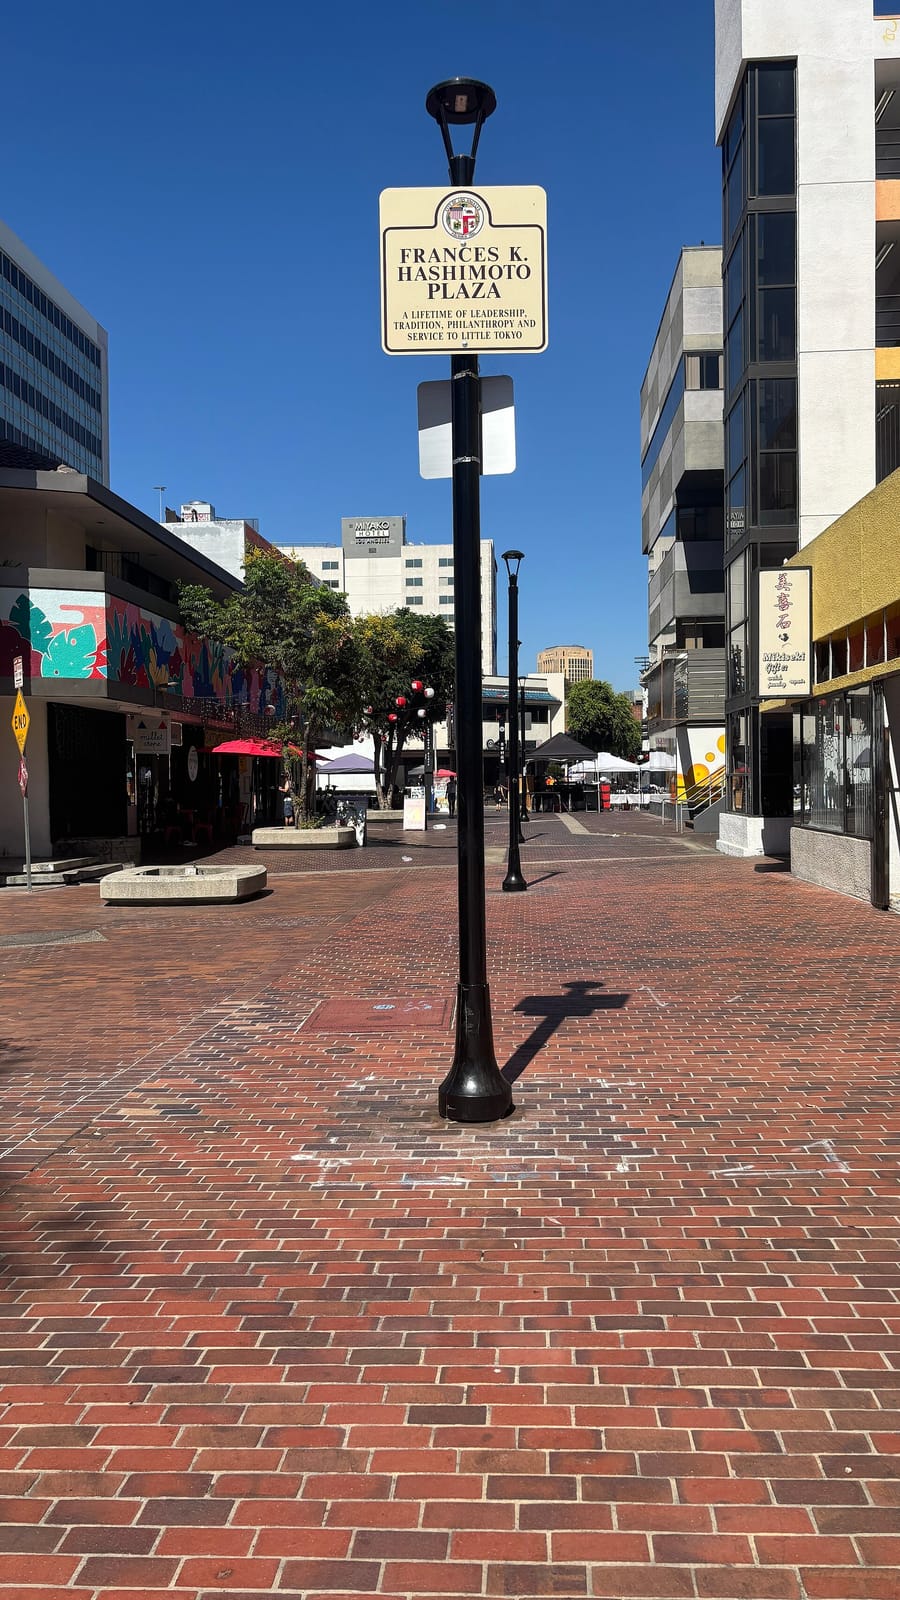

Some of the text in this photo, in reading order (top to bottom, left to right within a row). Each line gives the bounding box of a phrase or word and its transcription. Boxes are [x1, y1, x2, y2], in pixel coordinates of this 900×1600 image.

[400, 246, 528, 264] FRANCES K.
[398, 264, 530, 282] HASHIMOTO
[428, 282, 501, 300] PLAZA
[402, 309, 528, 319] A LIFETIME OF LEADERSHIP,
[394, 320, 536, 330] TRADITION, PHILANTHROPY AND
[408, 331, 522, 341] SERVICE TO LITTLE TOKYO
[355, 520, 390, 531] MIYAKO
[763, 652, 805, 662] Mikiseki
[14, 714, 26, 730] END
